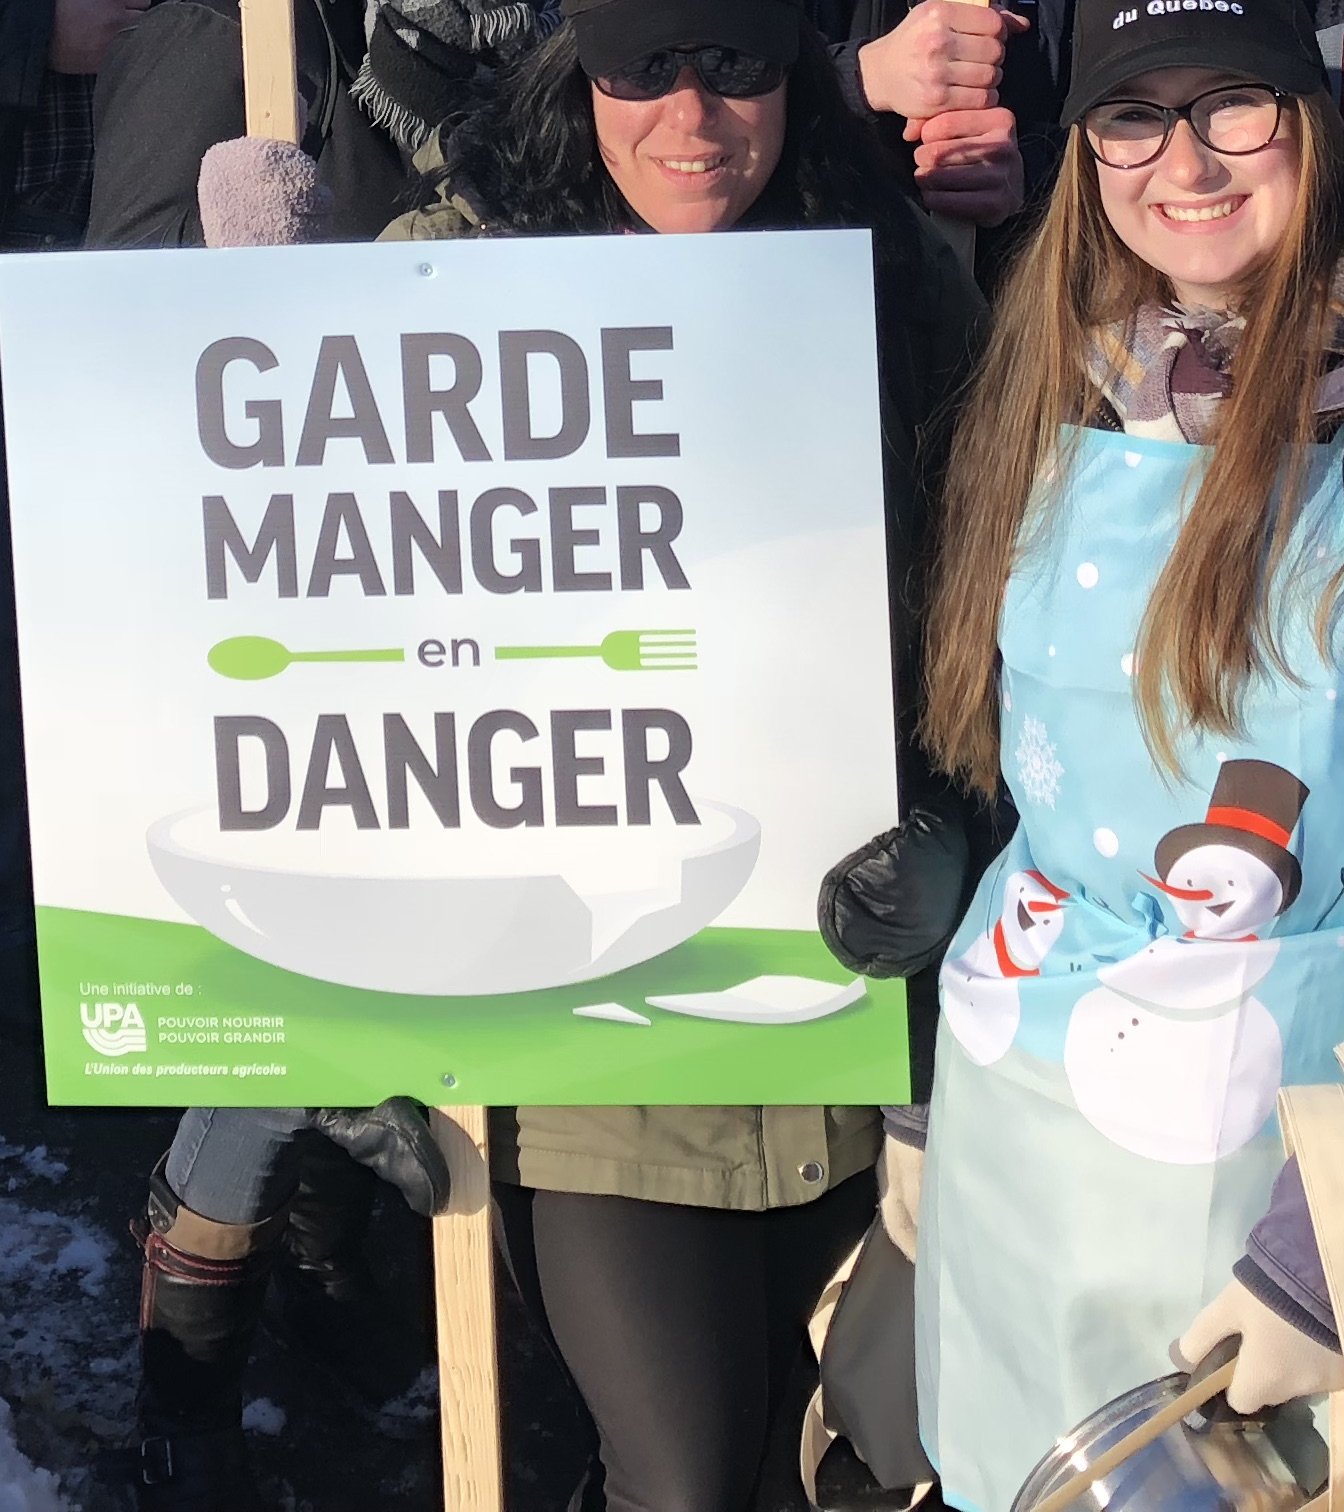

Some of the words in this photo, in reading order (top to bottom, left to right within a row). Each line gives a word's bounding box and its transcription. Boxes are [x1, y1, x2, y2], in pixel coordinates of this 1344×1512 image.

[1112, 7, 1138, 30] du
[193, 324, 681, 471] GARDE
[201, 485, 693, 602] MANGER
[416, 630, 481, 670] en
[212, 707, 702, 833] DANGER
[79, 982, 109, 996] Une
[113, 982, 171, 996] initiative
[175, 982, 194, 996] de
[80, 1003, 144, 1029] UPA
[157, 1017, 219, 1029] POUVOIR
[222, 1017, 284, 1029] NOURRIR
[158, 1032, 220, 1044] POUVOIR
[224, 1032, 286, 1044] GRANDIR
[84, 1062, 129, 1076] L'Union
[132, 1063, 153, 1076] des
[155, 1063, 228, 1078] producteurs
[232, 1063, 287, 1078] agricoles
